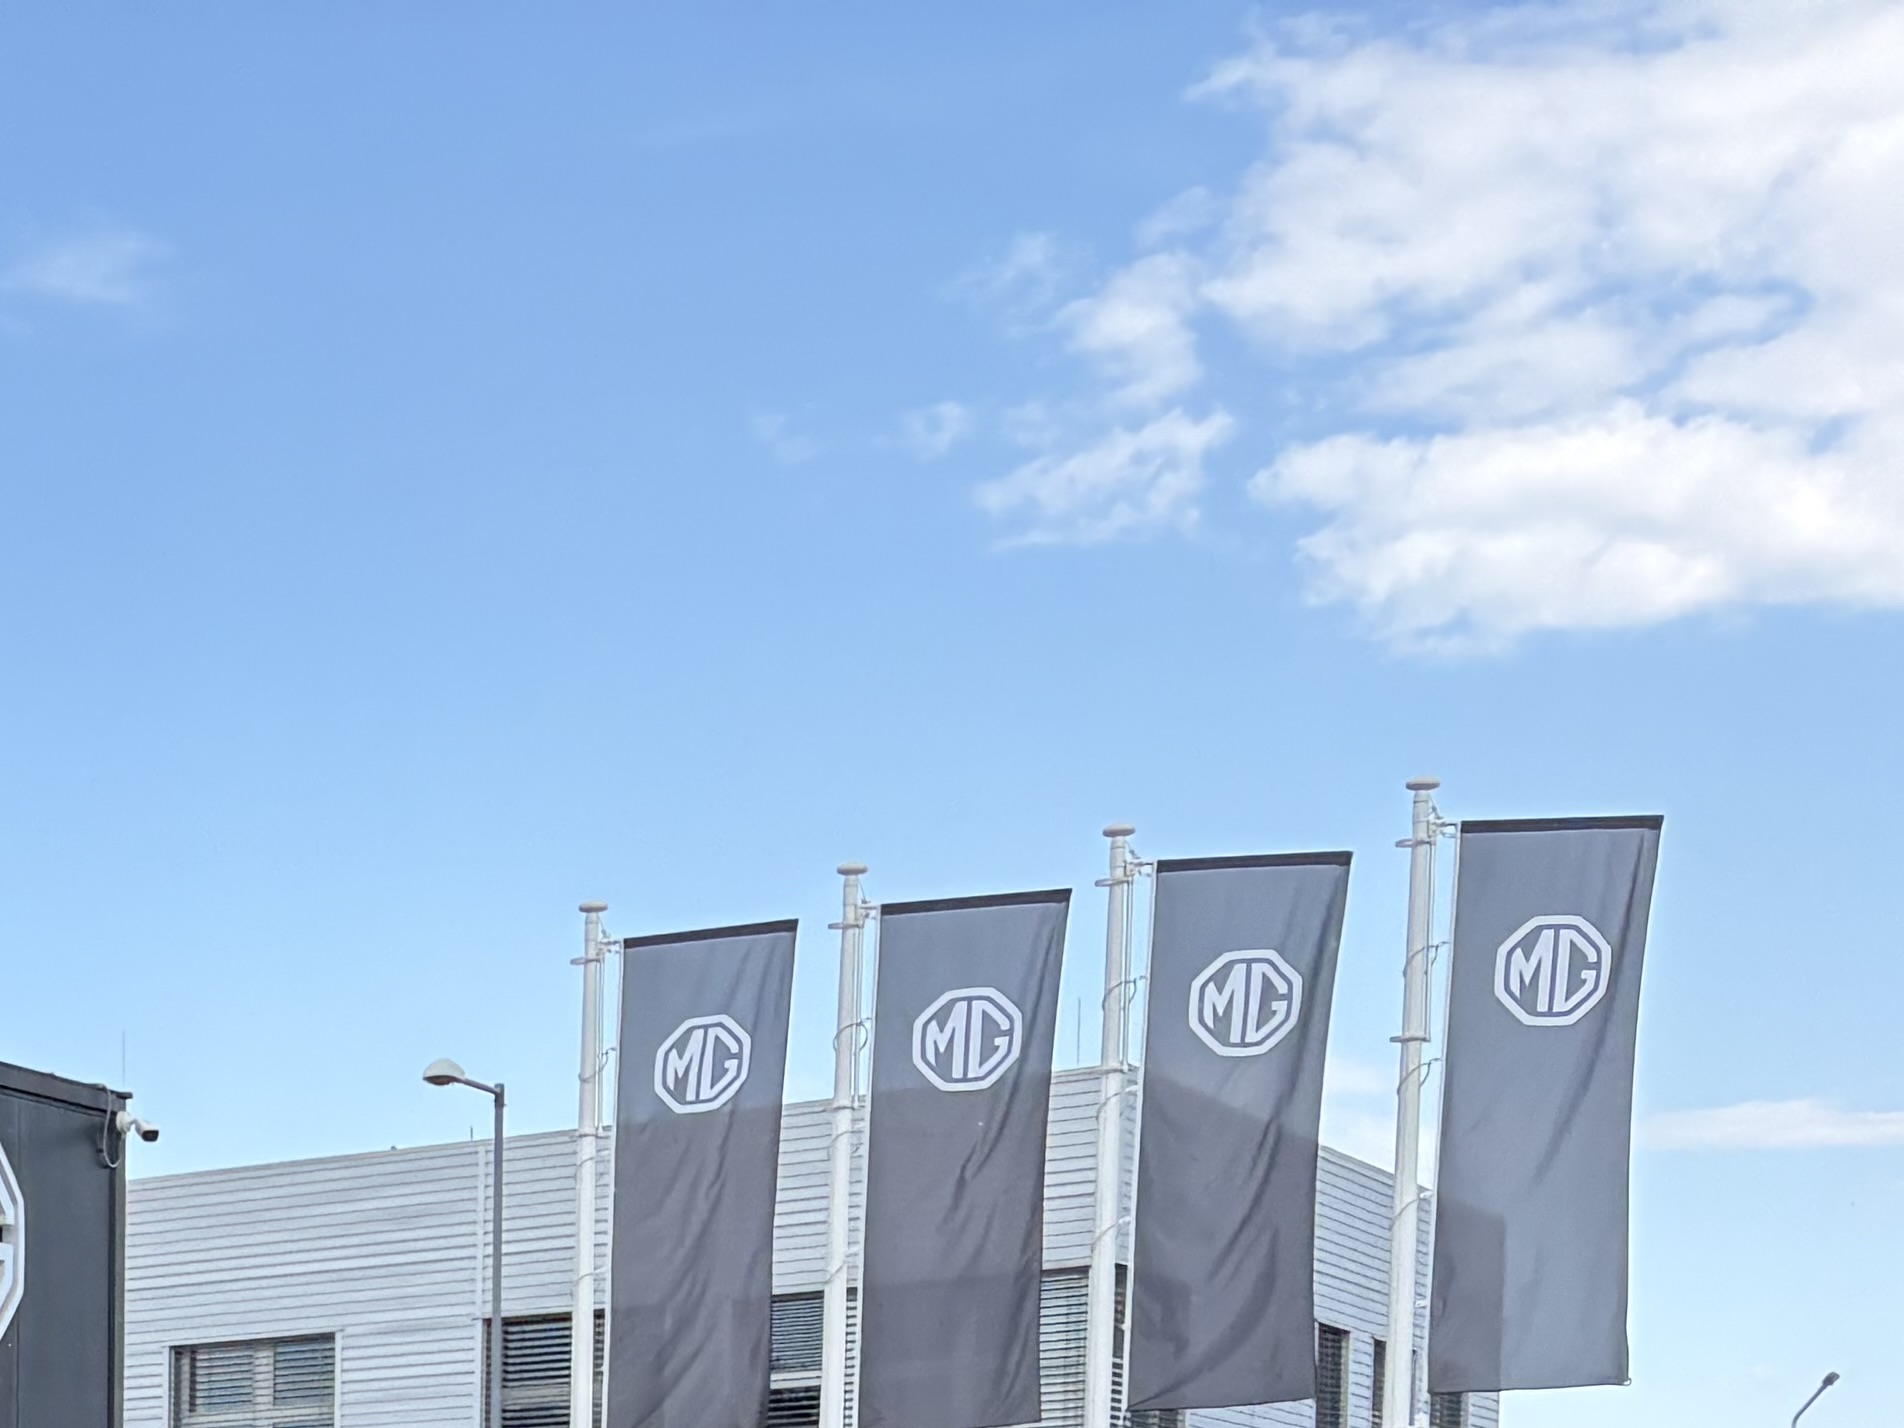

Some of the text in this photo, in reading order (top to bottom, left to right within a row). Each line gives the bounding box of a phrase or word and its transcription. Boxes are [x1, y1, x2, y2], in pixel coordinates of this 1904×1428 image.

[1198, 958, 1293, 1047] MG
[1501, 926, 1600, 1016] MG
[662, 1022, 744, 1104] MG
[920, 996, 1014, 1082] MG
